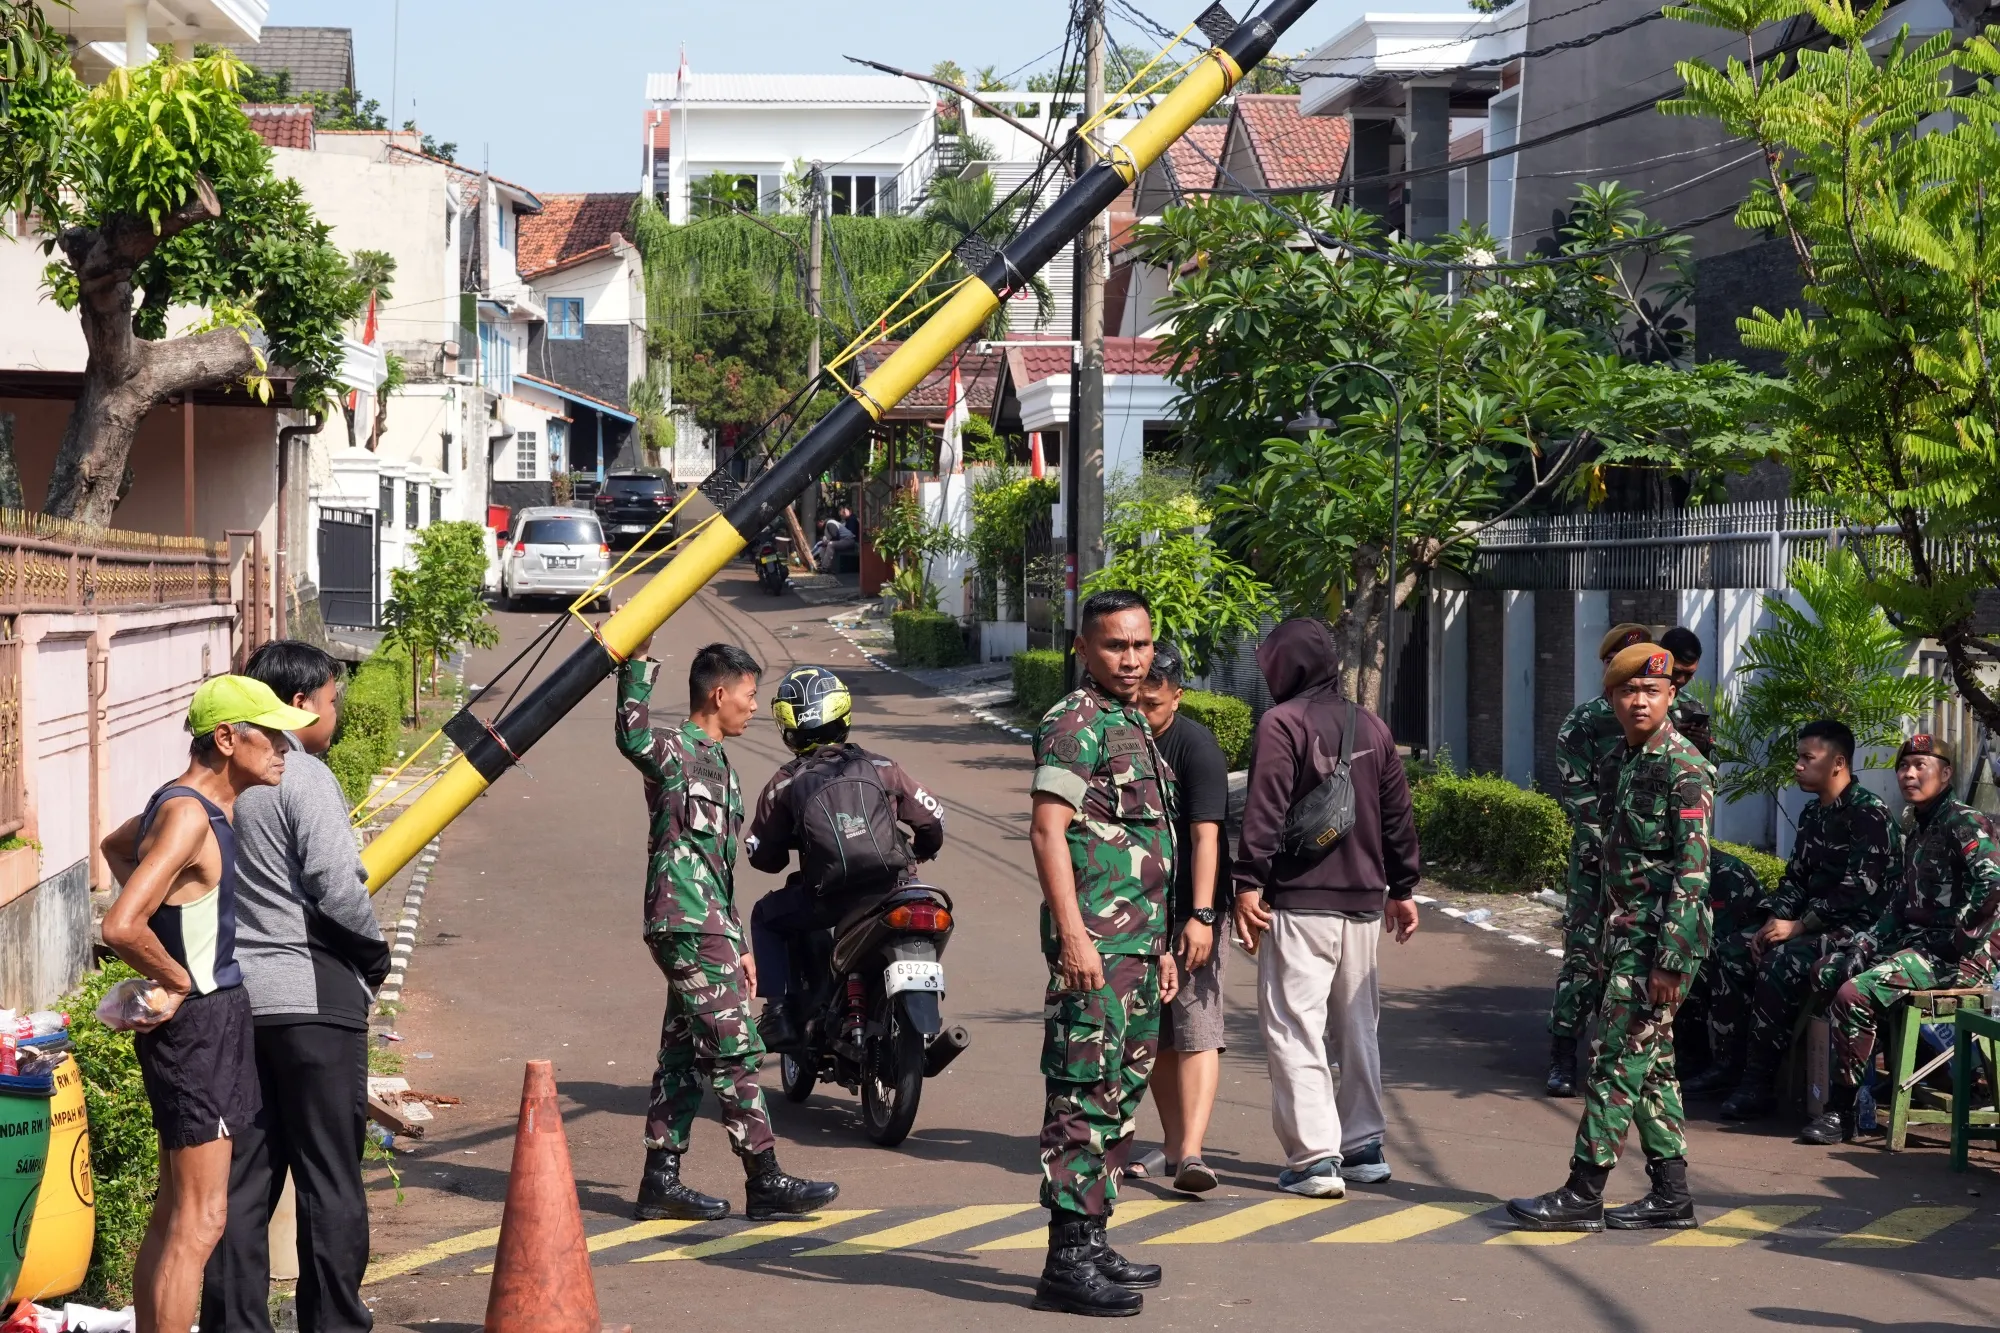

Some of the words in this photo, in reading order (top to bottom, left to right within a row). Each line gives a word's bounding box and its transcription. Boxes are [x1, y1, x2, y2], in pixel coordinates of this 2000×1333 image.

[885, 969, 891, 982] B
[897, 963, 929, 975] 6922
[51, 1108, 76, 1127] AMPAH
